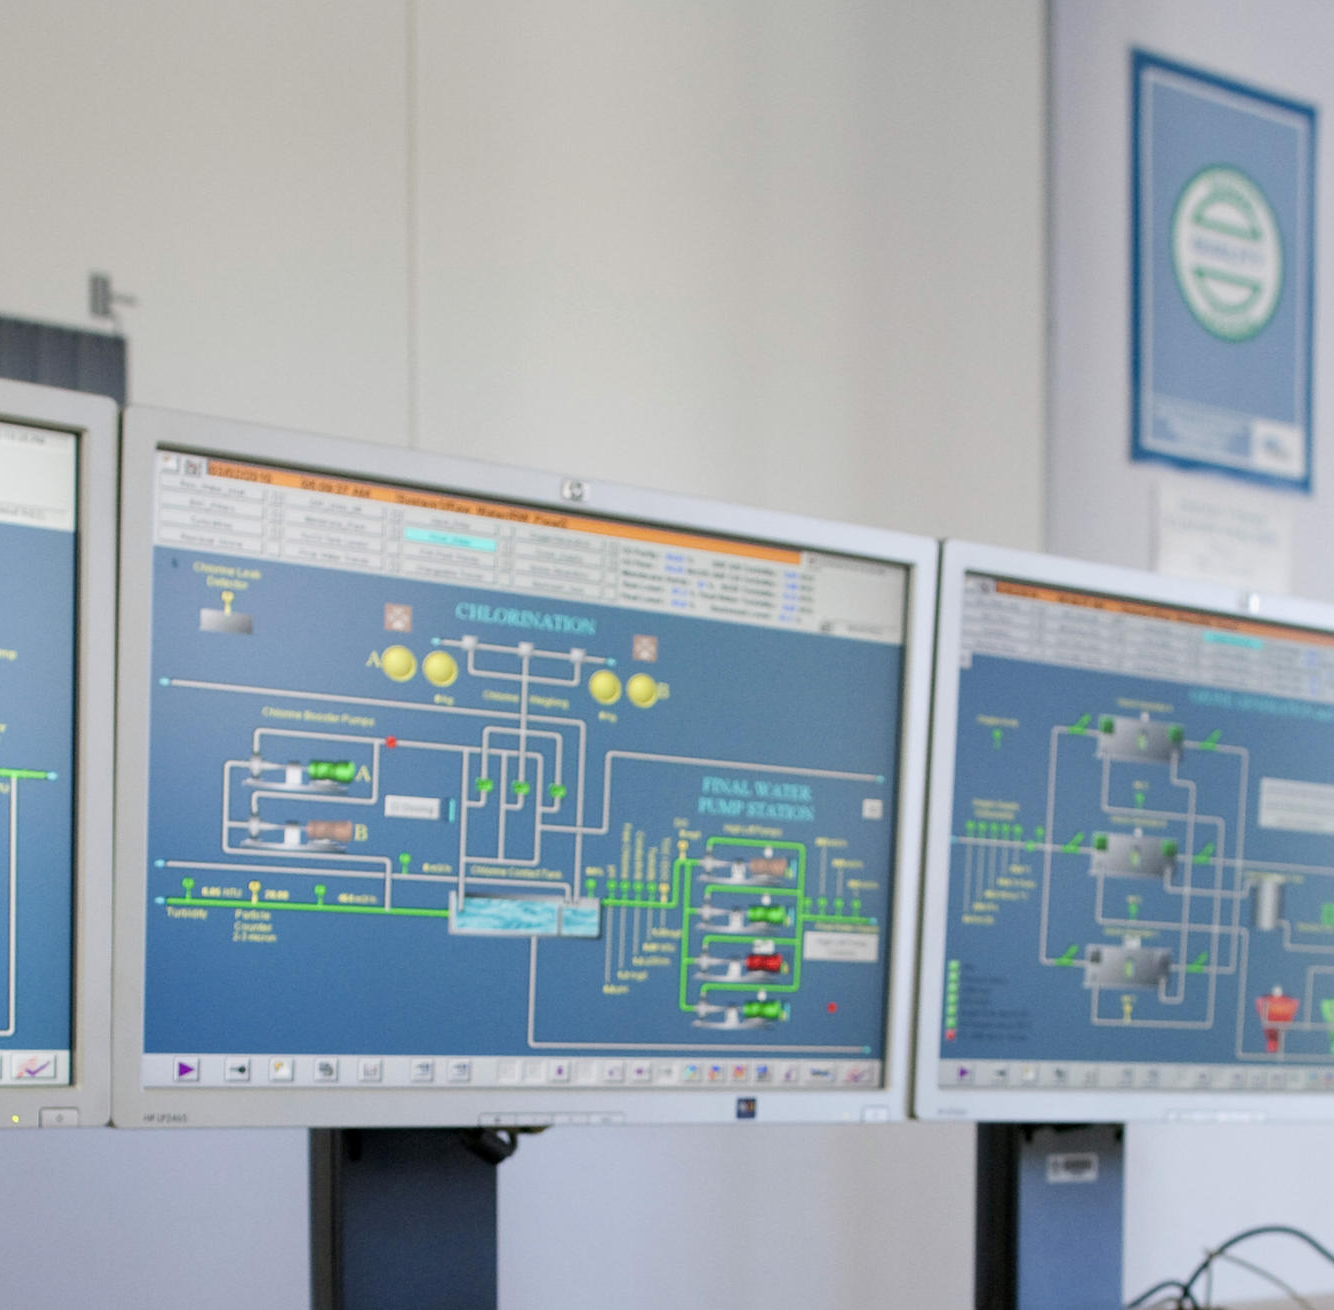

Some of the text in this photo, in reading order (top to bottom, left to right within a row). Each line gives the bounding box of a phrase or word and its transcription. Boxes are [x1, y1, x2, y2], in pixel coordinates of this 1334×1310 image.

[454, 604, 596, 636] CHLORINATION
[355, 765, 371, 783] A
[741, 799, 815, 820] STATION
[355, 824, 368, 841] B
